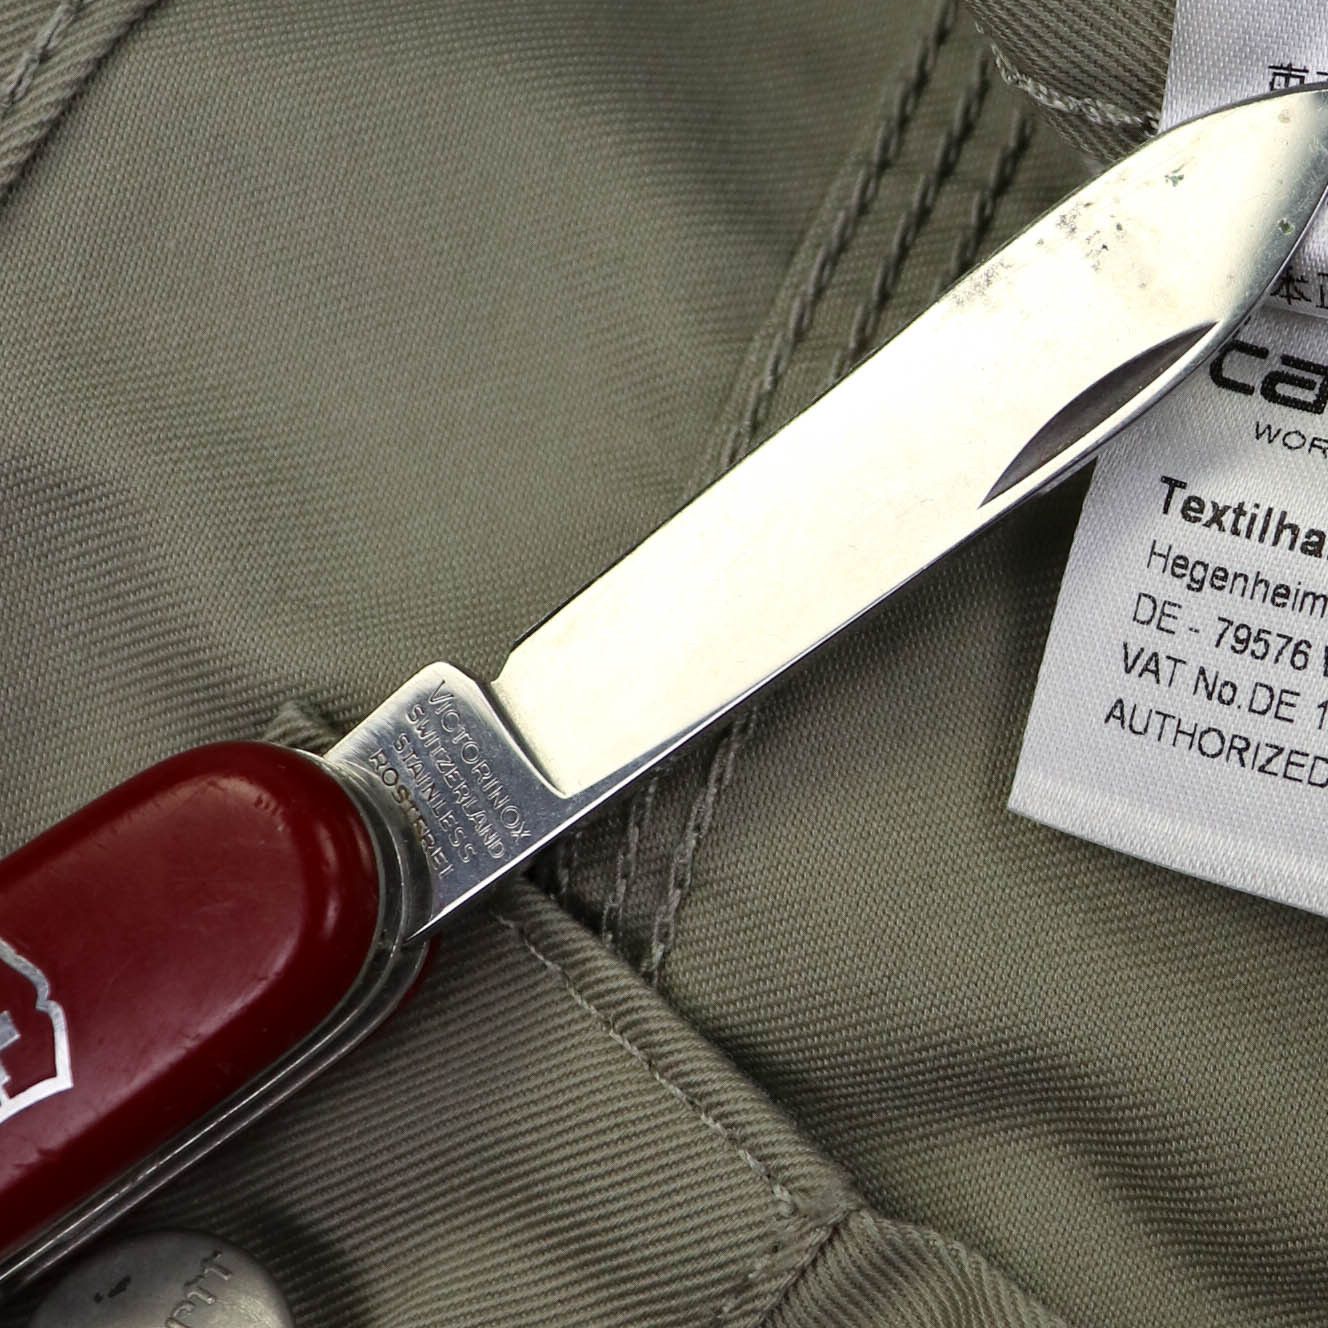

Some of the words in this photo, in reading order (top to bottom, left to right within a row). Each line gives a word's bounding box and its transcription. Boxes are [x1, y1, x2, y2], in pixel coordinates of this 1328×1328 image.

[1122, 641, 1186, 687] VAT
[1132, 592, 1182, 635] DE
[1214, 616, 1312, 671] 79576
[392, 732, 478, 863] STAINLESS
[405, 703, 506, 860] SWITZERLAND
[428, 679, 531, 841] VICTORINOX
